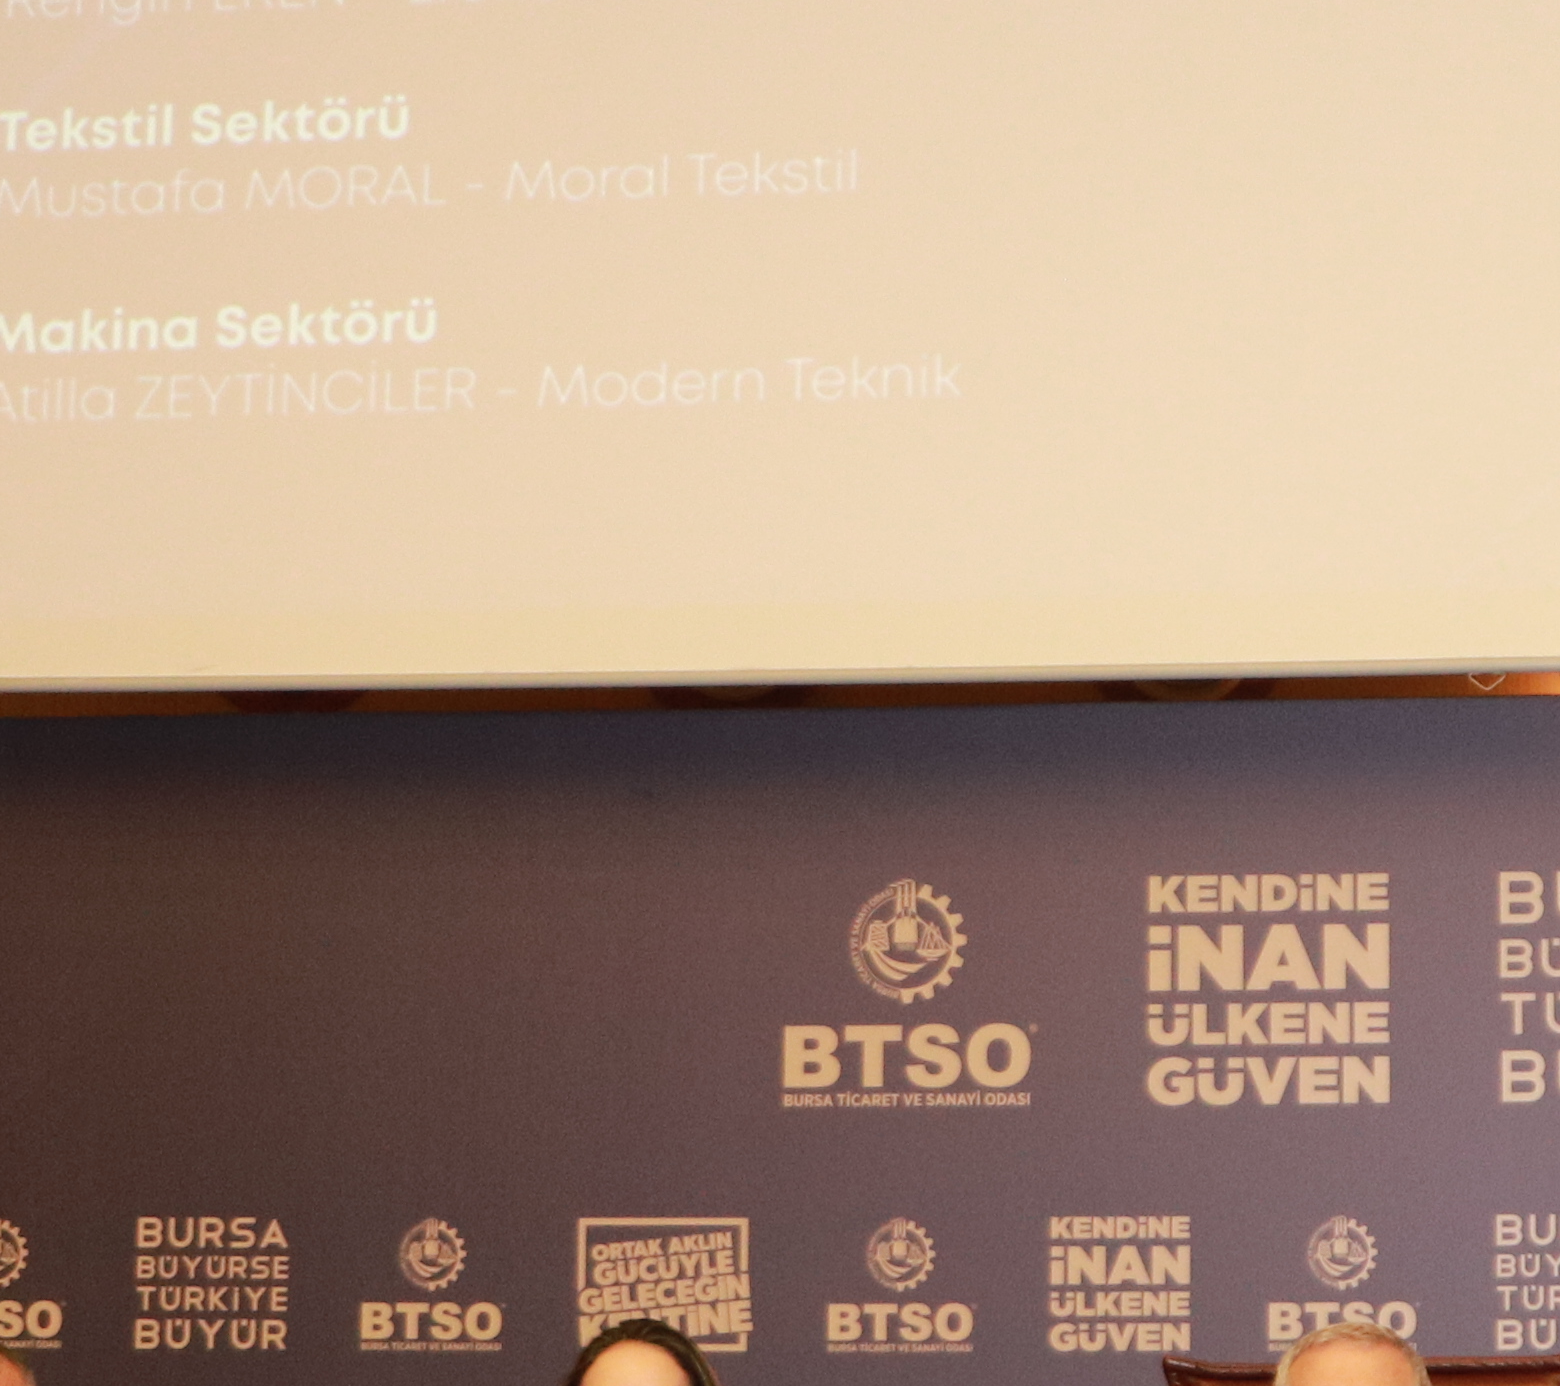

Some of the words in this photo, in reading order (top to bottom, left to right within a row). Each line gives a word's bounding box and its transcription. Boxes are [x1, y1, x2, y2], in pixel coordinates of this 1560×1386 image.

[189, 93, 411, 147] Sektörü
[243, 160, 448, 211] MORAL
[503, 153, 670, 203] Moral
[688, 147, 860, 197] Tekstil
[216, 296, 439, 350] Sektörü
[537, 360, 767, 410] Modern
[784, 354, 963, 404] Teknik
[1149, 1002, 1390, 1046] ÜLKENE
[783, 1023, 1032, 1088] BTSO
[783, 1093, 833, 1107] BURSA
[837, 1091, 899, 1107] TİCARET
[904, 1093, 922, 1106] VE
[984, 1093, 1031, 1106] ODASI
[1147, 1056, 1390, 1106] GÜVEN
[136, 1216, 288, 1249] BURSA
[134, 1318, 287, 1351] BÜYÜR
[360, 1302, 502, 1341] BTSO
[827, 1302, 973, 1342] BTSO
[1049, 1322, 1191, 1352] GÜVEN
